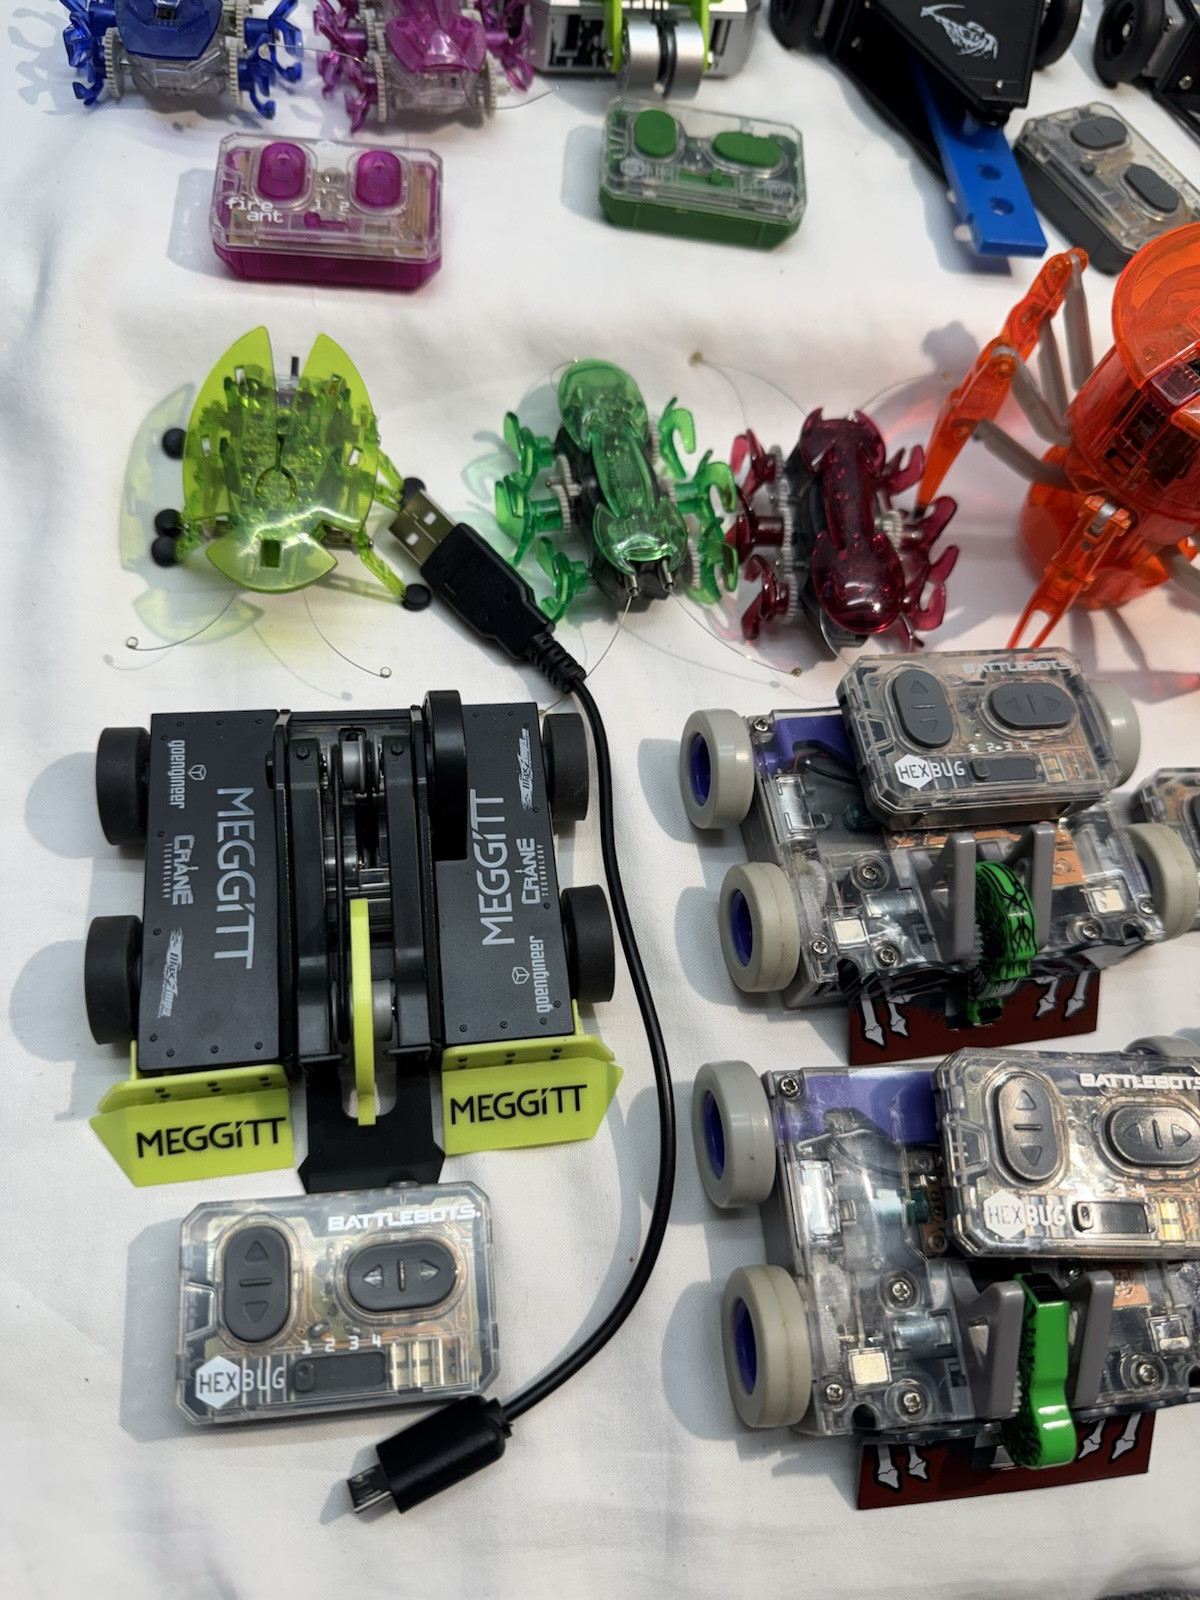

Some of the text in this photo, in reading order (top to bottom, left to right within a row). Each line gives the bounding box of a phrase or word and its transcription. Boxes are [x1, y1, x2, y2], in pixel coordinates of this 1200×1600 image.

[225, 197, 274, 213] fire
[247, 209, 284, 224] ant
[168, 739, 186, 810] goengineer
[898, 760, 966, 780] HEXBUG
[172, 834, 199, 906] CRANE
[515, 837, 541, 905] CRANE
[529, 935, 554, 1014] goengineer
[328, 1204, 477, 1232] BATTLEBOTS
[986, 1204, 1067, 1227] HEXBUG
[302, 1334, 382, 1355] 1 2 3 4
[199, 1366, 286, 1394] HEXBUG
